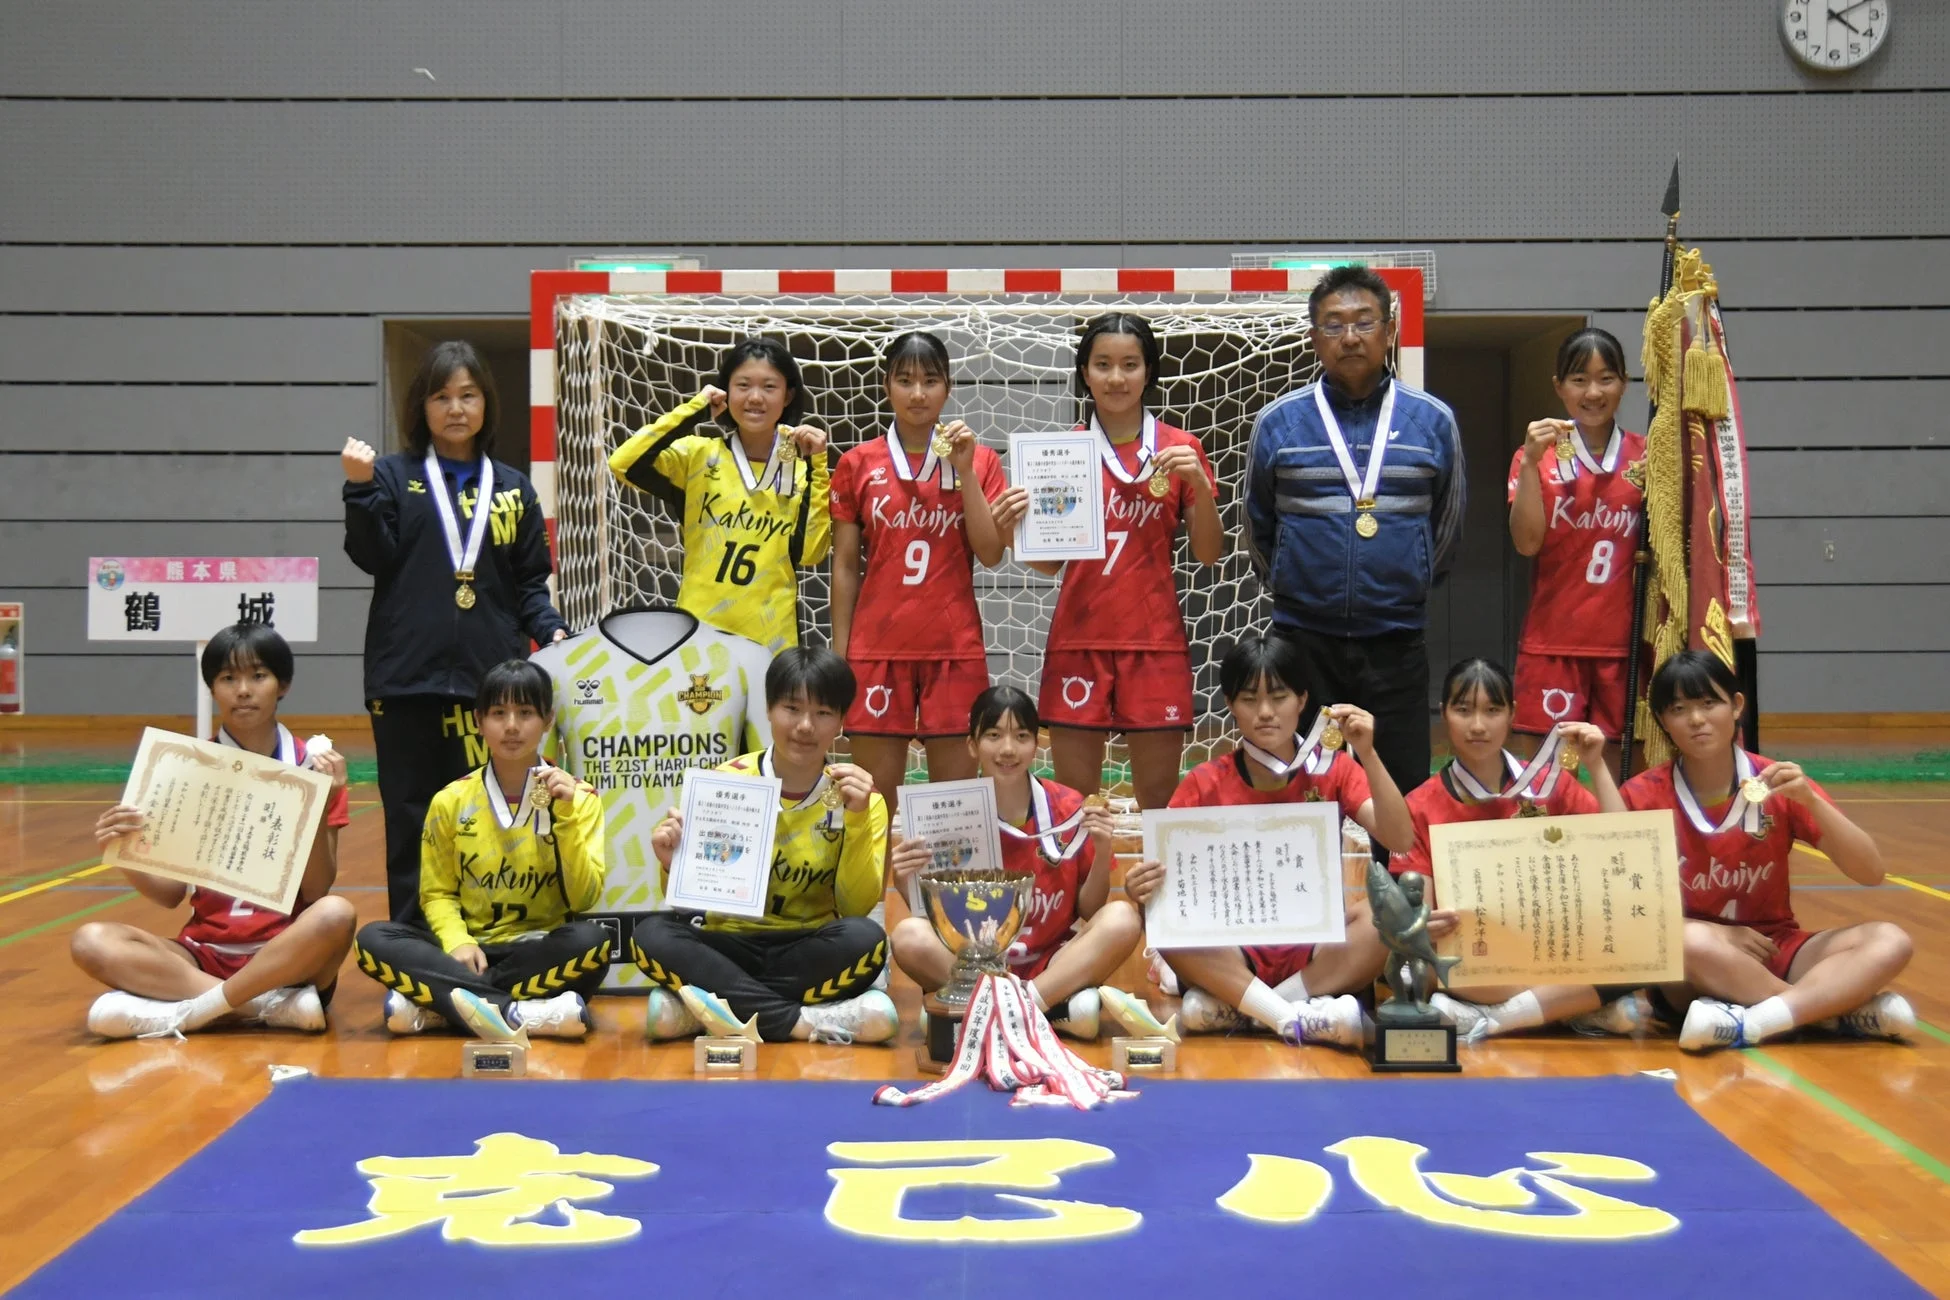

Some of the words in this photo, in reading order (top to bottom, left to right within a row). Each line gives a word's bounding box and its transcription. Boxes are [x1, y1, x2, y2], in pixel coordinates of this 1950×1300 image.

[1790, 11, 1802, 22] 9
[1869, 8, 1880, 21] 3
[1795, 29, 1807, 41] 8
[1862, 27, 1874, 38] 4
[1811, 45, 1821, 56] 7
[1828, 49, 1841, 61] 6
[1849, 43, 1861, 54] 5
[1550, 496, 1638, 538] Kakujy
[903, 540, 930, 585] 9
[1102, 531, 1129, 576] 7
[1585, 540, 1614, 584] 8
[166, 561, 238, 581] 熊本県
[715, 541, 761, 586] 16
[573, 696, 604, 706] hummel
[678, 689, 723, 701] CHAMPION
[583, 733, 728, 759] CHAMPIONS
[584, 760, 612, 774] THE
[616, 759, 648, 773] 21ST
[584, 775, 616, 789] HIMI
[624, 773, 684, 788] TOYAMA
[263, 815, 283, 861] 表彰状
[1293, 853, 1308, 893] 賞状
[1629, 873, 1646, 918] 賞状
[292, 1131, 1682, 1246] 克己心
